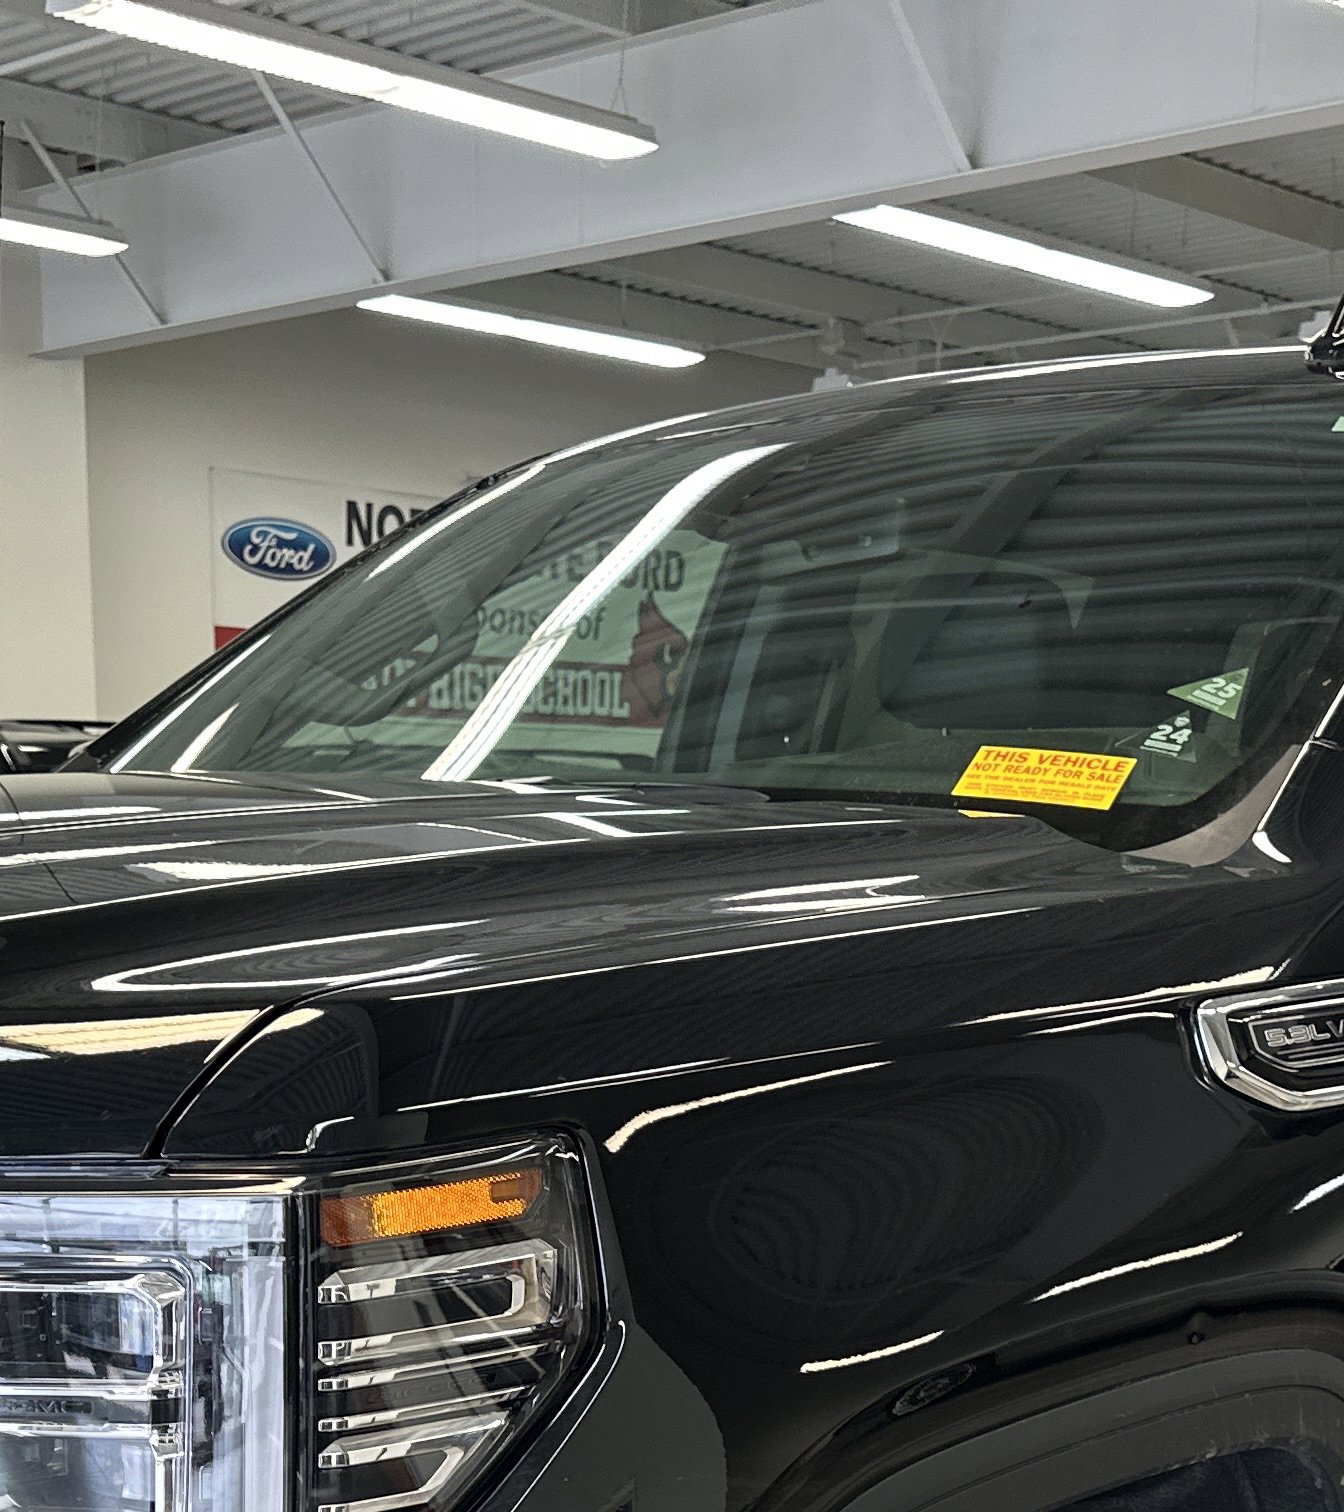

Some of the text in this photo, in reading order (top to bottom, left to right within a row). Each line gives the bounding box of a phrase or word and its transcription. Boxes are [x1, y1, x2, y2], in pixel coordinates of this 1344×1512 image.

[243, 531, 315, 572] Ford
[576, 607, 606, 640] of
[1201, 677, 1242, 698] 25
[1148, 724, 1193, 744] 24
[971, 761, 1124, 784] NOT READY FOR SALE
[981, 749, 1131, 773] THIS VEHICLE
